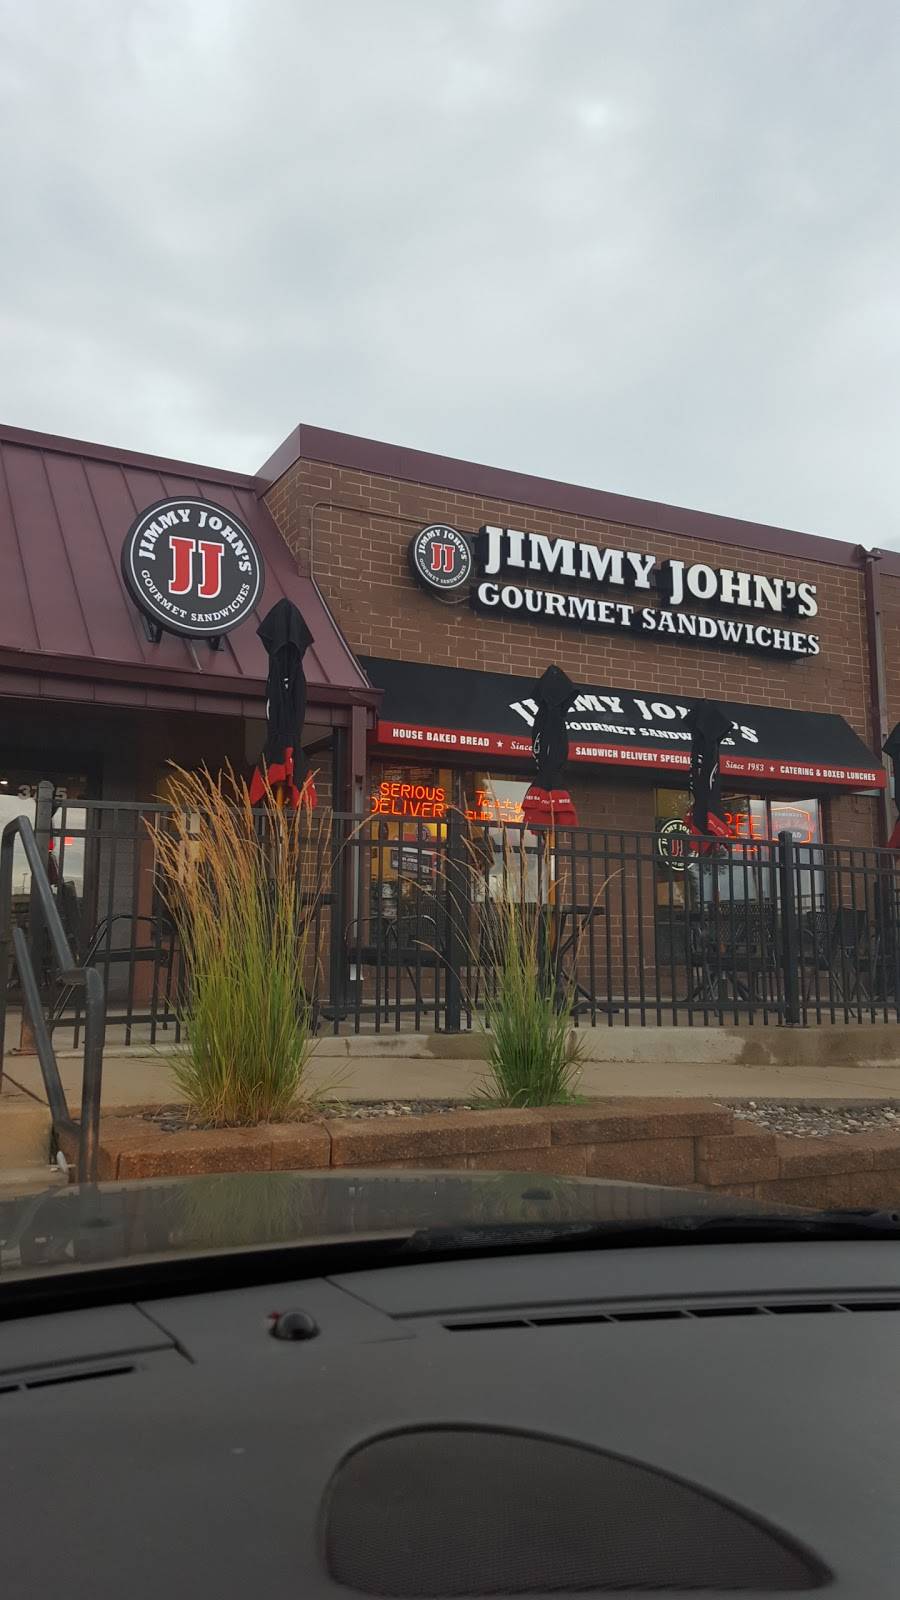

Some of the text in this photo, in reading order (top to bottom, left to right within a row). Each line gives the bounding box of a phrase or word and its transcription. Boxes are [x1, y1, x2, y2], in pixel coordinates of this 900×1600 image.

[139, 509, 252, 575] JIMMY JOHN'S
[418, 529, 441, 554] JIMMY
[168, 536, 225, 599] JJ
[431, 542, 455, 573] JJ
[485, 525, 818, 617] JIMMY JOHN'S
[141, 569, 250, 622] GOURMET SANDWICHES
[477, 582, 820, 655] GOURMET SANDWICHES
[509, 694, 625, 728] JIMY
[392, 728, 533, 752] HOUSE BAKED BREAD Since
[575, 747, 619, 759] SANDWICH
[620, 751, 658, 762] DELIVERY
[725, 760, 744, 771] Since
[780, 765, 814, 777] CATERING
[816, 768, 822, 777] &
[823, 769, 845, 779] BOXED
[846, 772, 876, 781] LUNCHES
[18, 784, 67, 800] 375
[380, 782, 445, 802] SERIOUS
[371, 796, 447, 818] DELIVER
